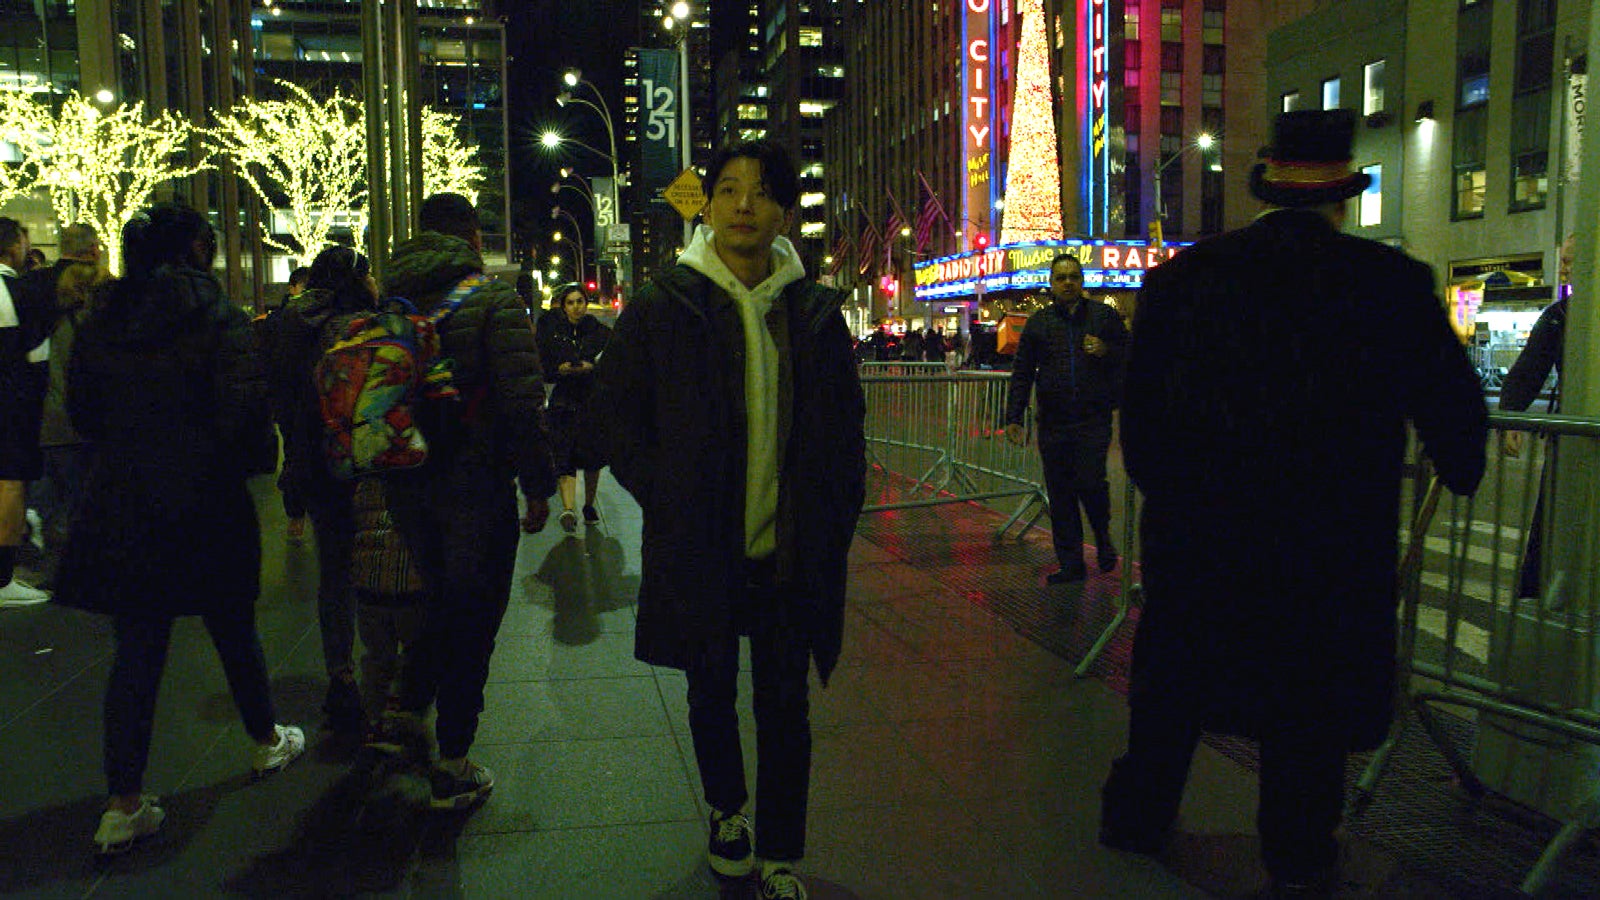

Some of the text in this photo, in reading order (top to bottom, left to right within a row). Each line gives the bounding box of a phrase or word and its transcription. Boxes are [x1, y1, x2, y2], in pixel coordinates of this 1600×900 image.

[968, 39, 990, 148] CITY
[1092, 0, 1106, 108] ITY
[939, 258, 972, 282] RADIO
[1008, 248, 1055, 271] Music
